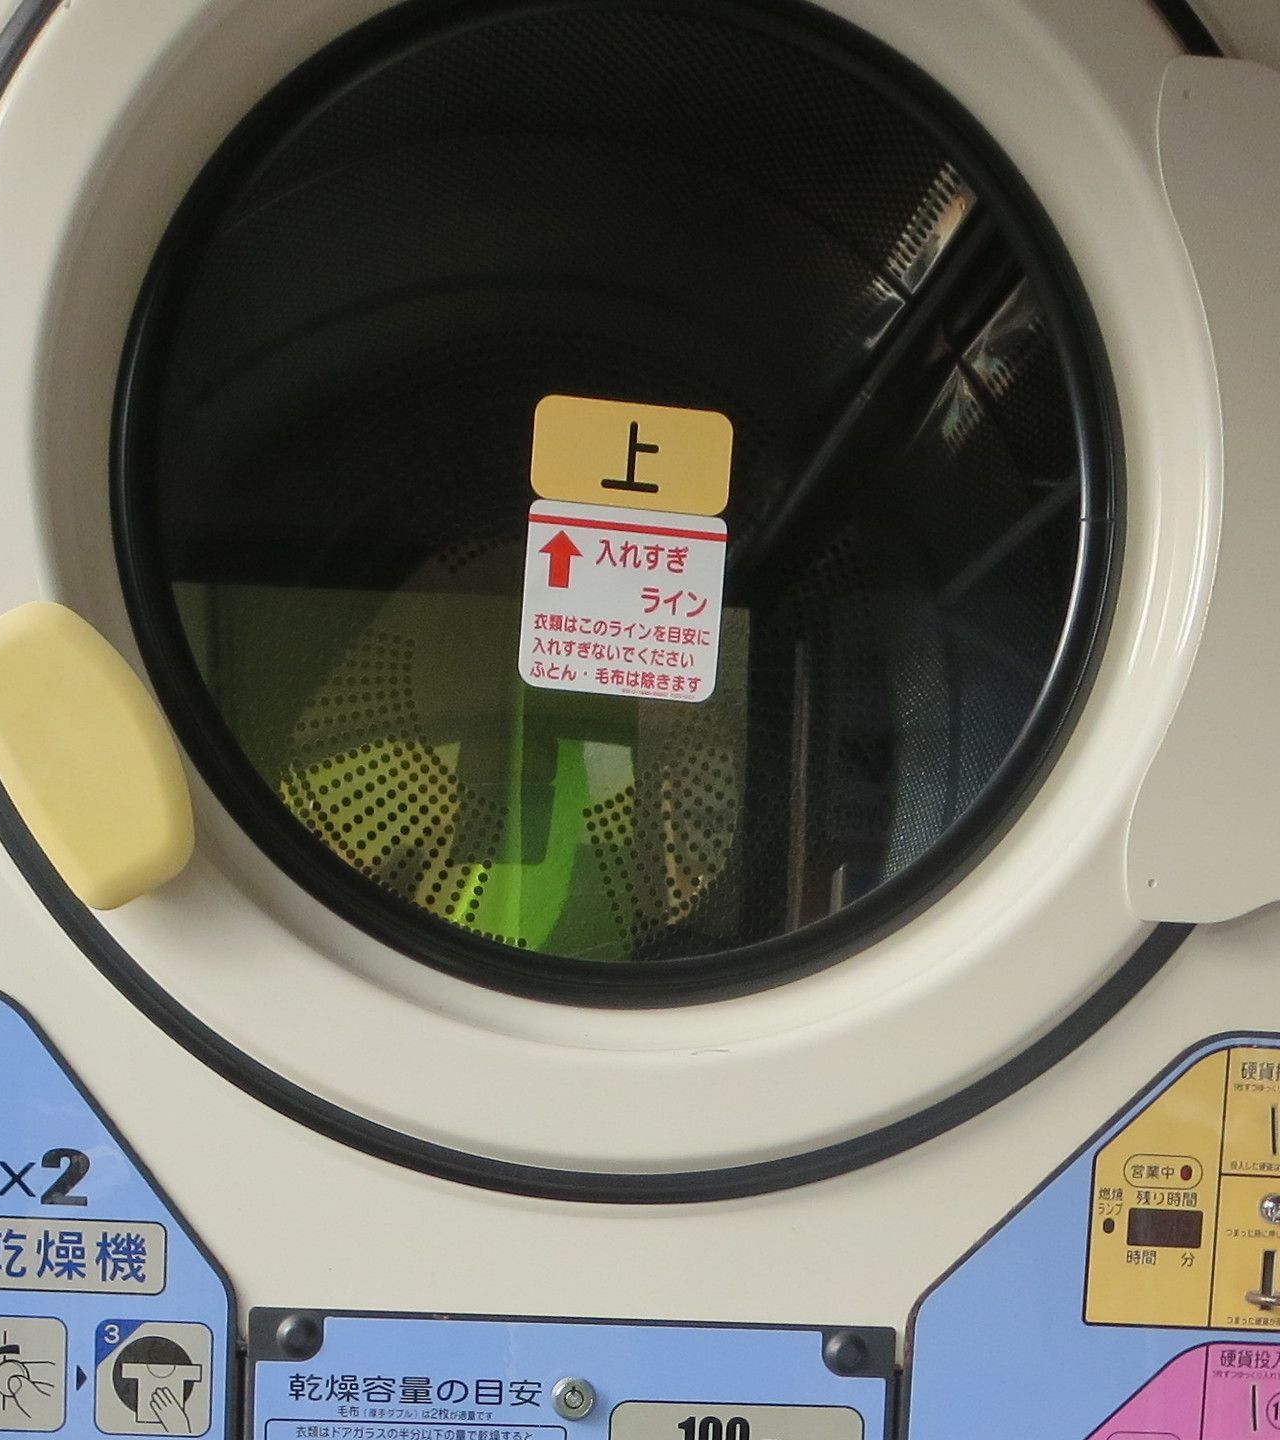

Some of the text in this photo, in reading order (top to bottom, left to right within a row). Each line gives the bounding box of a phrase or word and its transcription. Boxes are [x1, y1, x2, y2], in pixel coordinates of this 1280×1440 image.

[601, 420, 659, 493] 上
[595, 539, 689, 573] 入れすぎ
[640, 587, 707, 618] ライン
[534, 613, 710, 646] 衣類はこのラインを目安に
[532, 637, 694, 668] 入れすぎないでください
[529, 661, 702, 693] ふとん・毛布は除きます
[1131, 1165, 1175, 1179] 営業中
[1136, 1191, 1198, 1207] 残り時間
[1126, 1250, 1195, 1267] 時間 分
[104, 1324, 120, 1344] 3
[288, 1374, 542, 1407] 乾燥容量の目安
